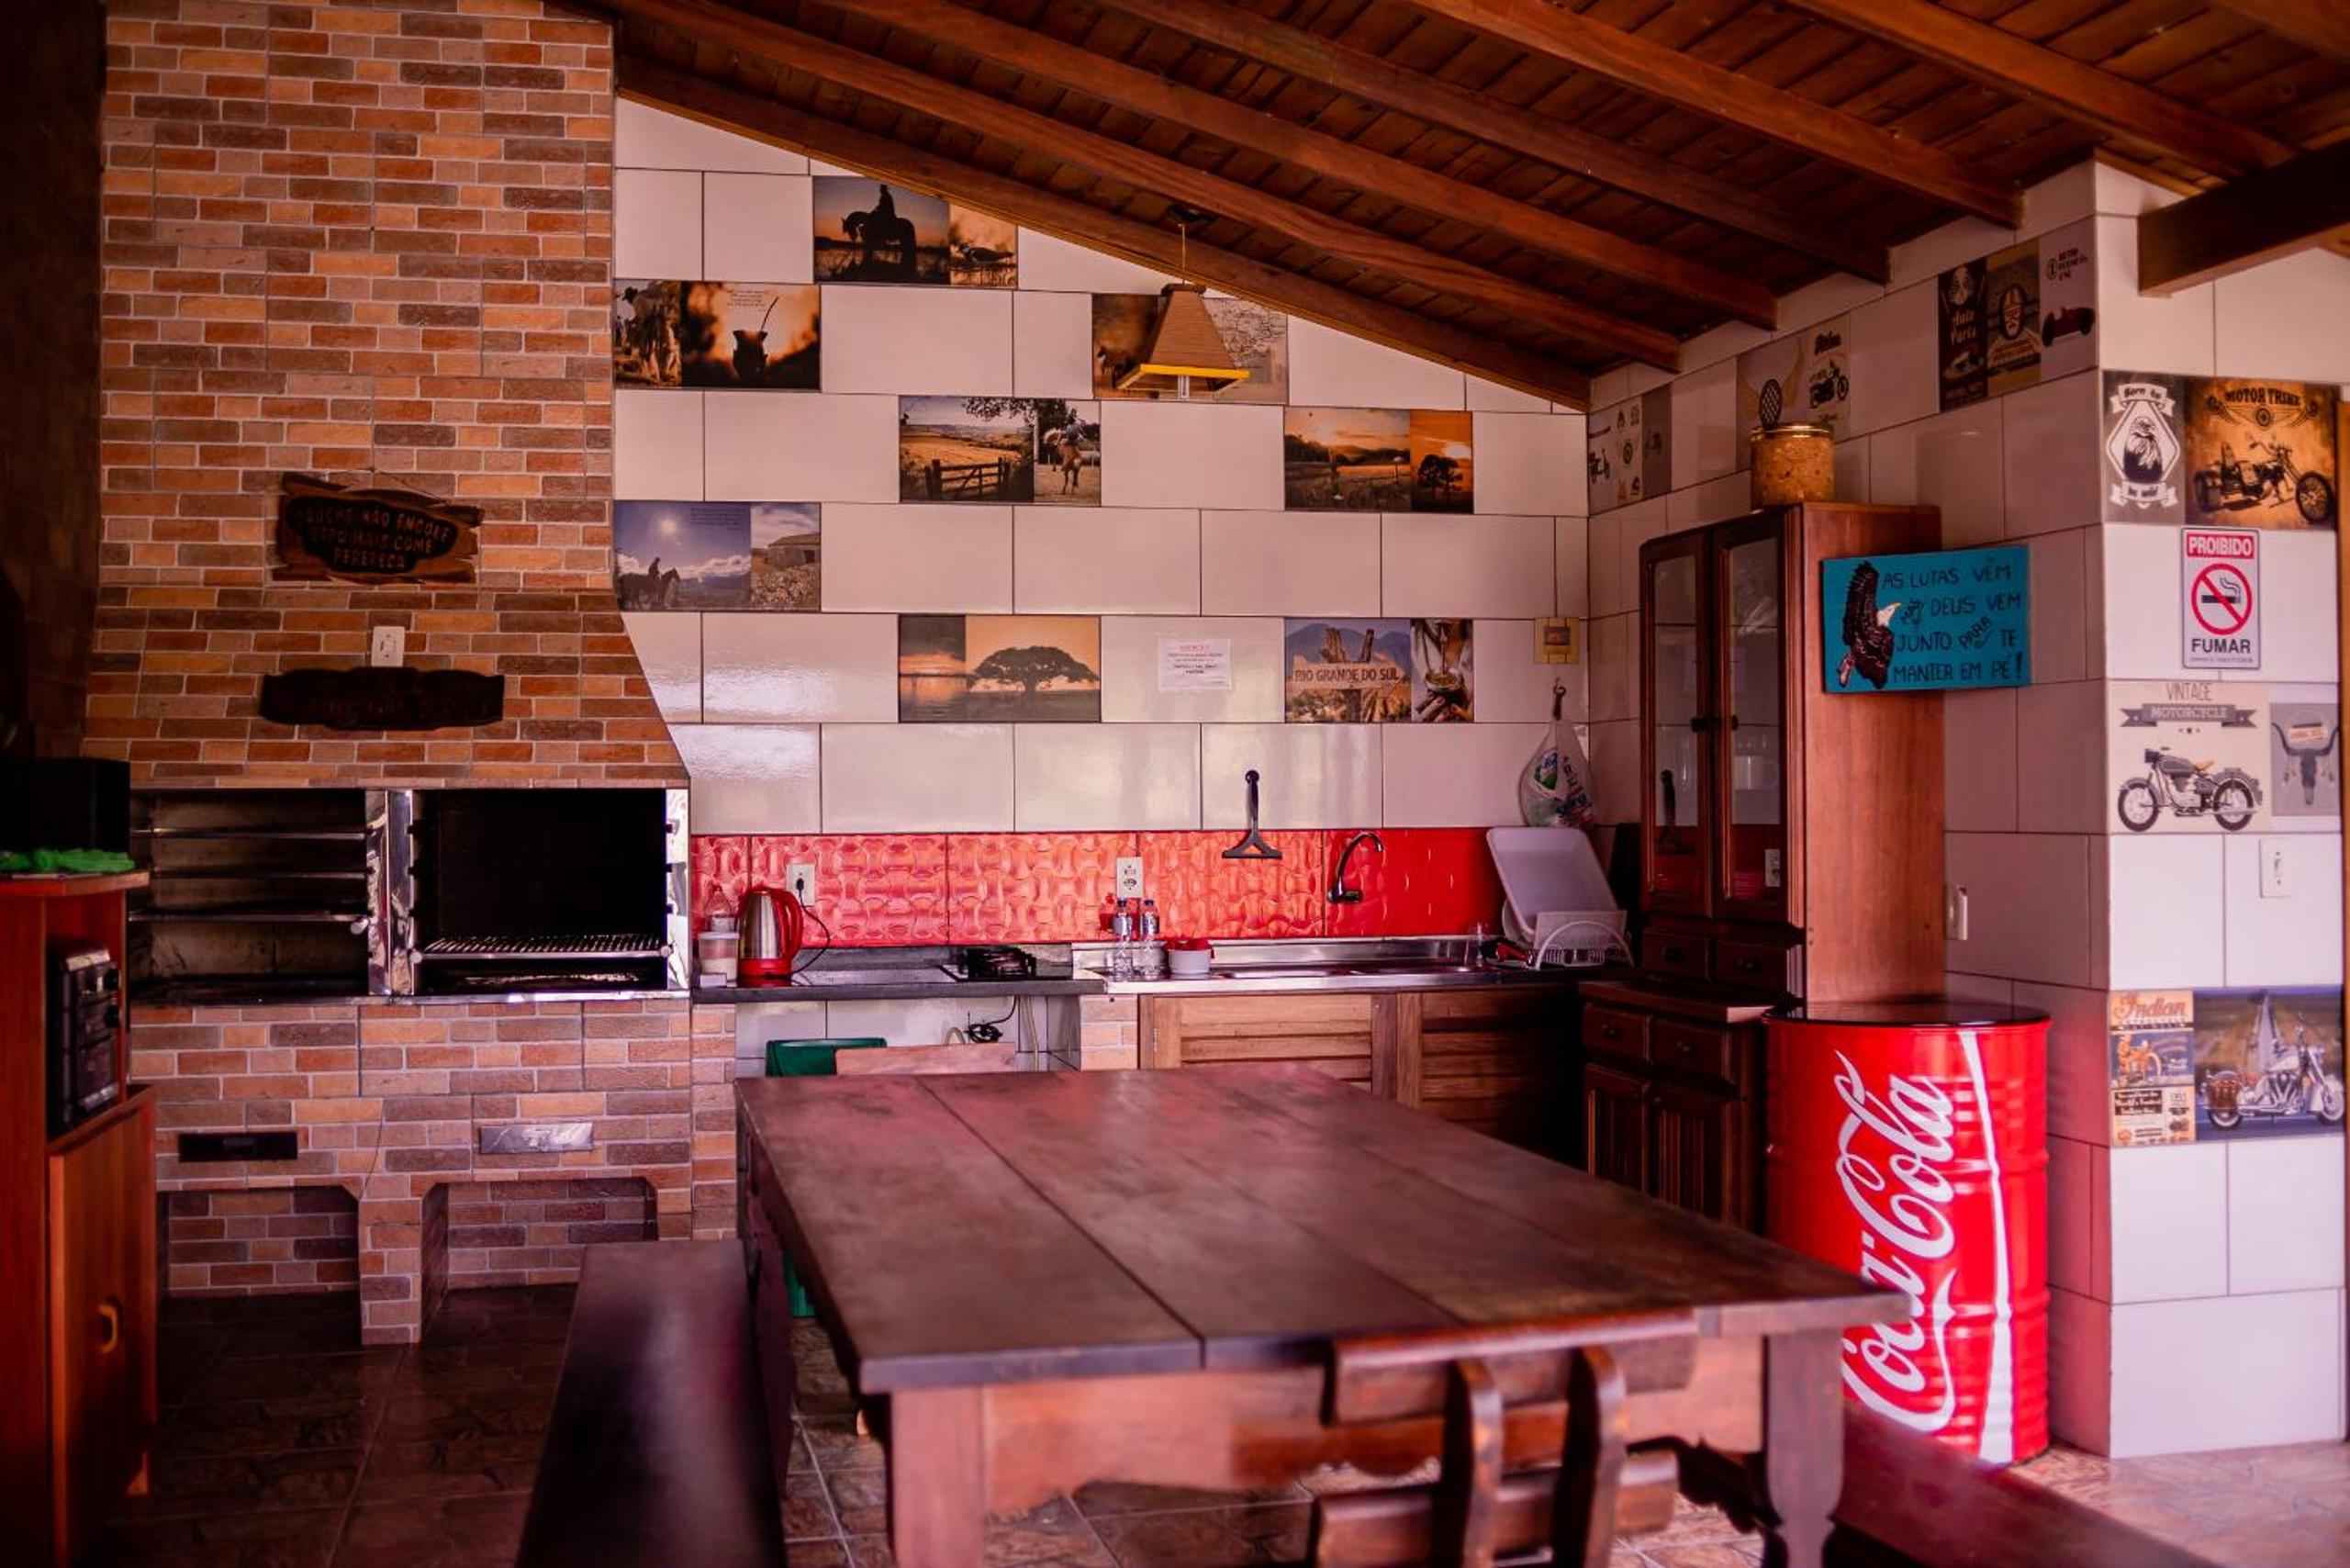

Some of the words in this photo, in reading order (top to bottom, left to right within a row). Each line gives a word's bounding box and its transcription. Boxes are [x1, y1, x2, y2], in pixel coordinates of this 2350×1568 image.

[2225, 387, 2266, 404] MOTOR
[393, 533, 436, 554] COME
[2188, 536, 2253, 555] PROIBIDO
[1883, 572, 1905, 589] AS
[1909, 567, 1960, 588] LUTAS
[1930, 597, 1975, 617] DEUS
[1986, 593, 2020, 611] VEM
[1895, 630, 1952, 653] JUNTO
[1958, 616, 1993, 649] PARA
[2000, 628, 2018, 647] TE
[2191, 638, 2252, 654] FUMAR
[1295, 670, 1314, 681] RIO
[1315, 668, 1360, 681] GRANDE
[1361, 669, 1377, 680] DO
[1379, 667, 1400, 681] SUL
[1893, 660, 1953, 683] MANTER
[1961, 662, 1982, 679] EM
[2166, 681, 2213, 700] VINTAGE
[2114, 991, 2186, 1018] Indian
